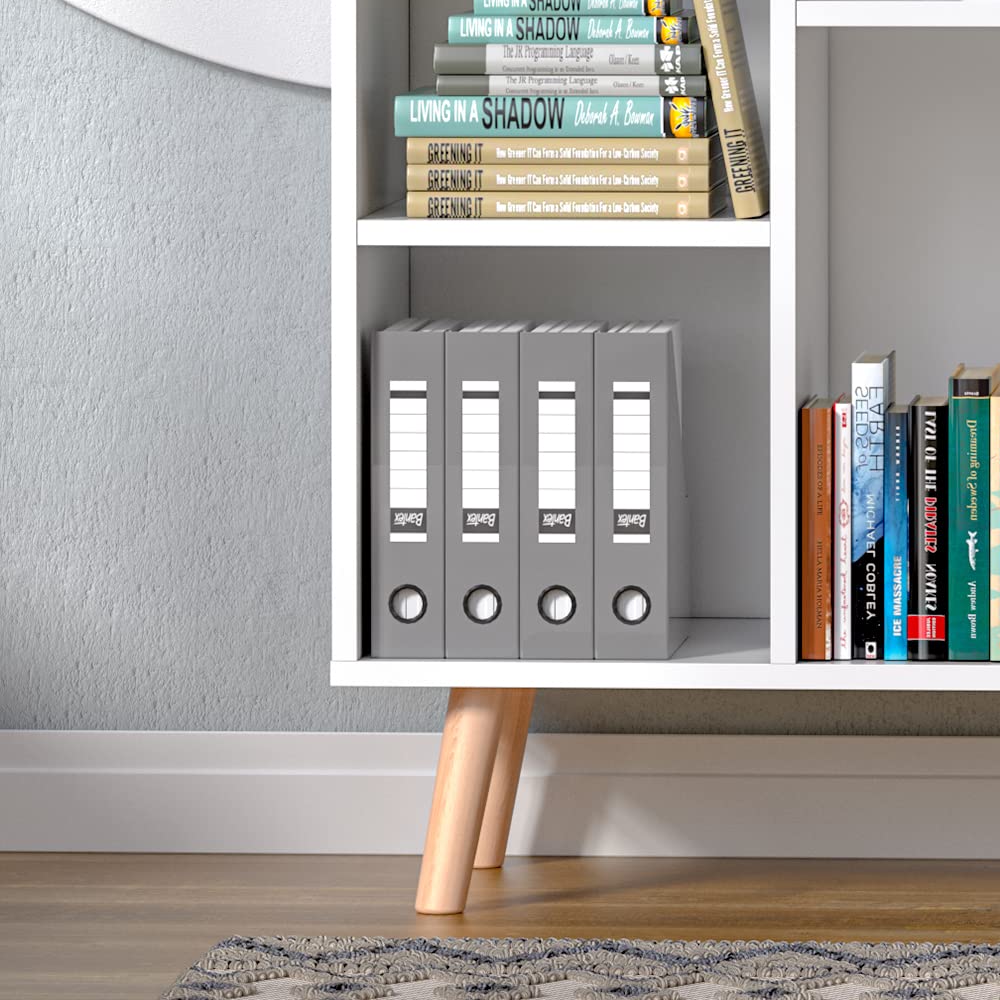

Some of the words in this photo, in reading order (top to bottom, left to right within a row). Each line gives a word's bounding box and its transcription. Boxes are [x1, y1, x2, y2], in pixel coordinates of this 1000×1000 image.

[460, 17, 492, 38] LIVING
[494, 17, 504, 37] IN
[506, 17, 514, 37] A
[516, 17, 580, 41] SHADOW
[587, 18, 613, 40] Deborah
[625, 18, 650, 39] Bowman
[503, 44, 513, 58] The
[525, 44, 563, 62] Programming
[565, 45, 594, 62] Language
[506, 76, 517, 84] The
[528, 76, 567, 89] Programming
[569, 76, 598, 87] Language
[410, 99, 450, 123] LIVING
[454, 99, 466, 123] IN
[469, 99, 479, 123] A
[481, 97, 565, 130] SHADOW
[574, 100, 608, 126] Deborah
[609, 100, 619, 126] A.
[623, 100, 655, 126] Bowman
[724, 127, 744, 137] IT
[427, 143, 472, 164] GREENING
[474, 143, 483, 164] IT
[727, 139, 755, 194] GREENING
[427, 170, 472, 191] GREENING
[474, 170, 483, 191] IT
[427, 197, 472, 218] GREENING
[474, 197, 483, 218] IT
[394, 511, 424, 527] Bantex
[466, 511, 496, 527] Bantex
[542, 512, 572, 528] Bantex
[617, 512, 647, 528] Bantex
[892, 555, 902, 616] MASSACRE
[892, 619, 902, 637] ICE
